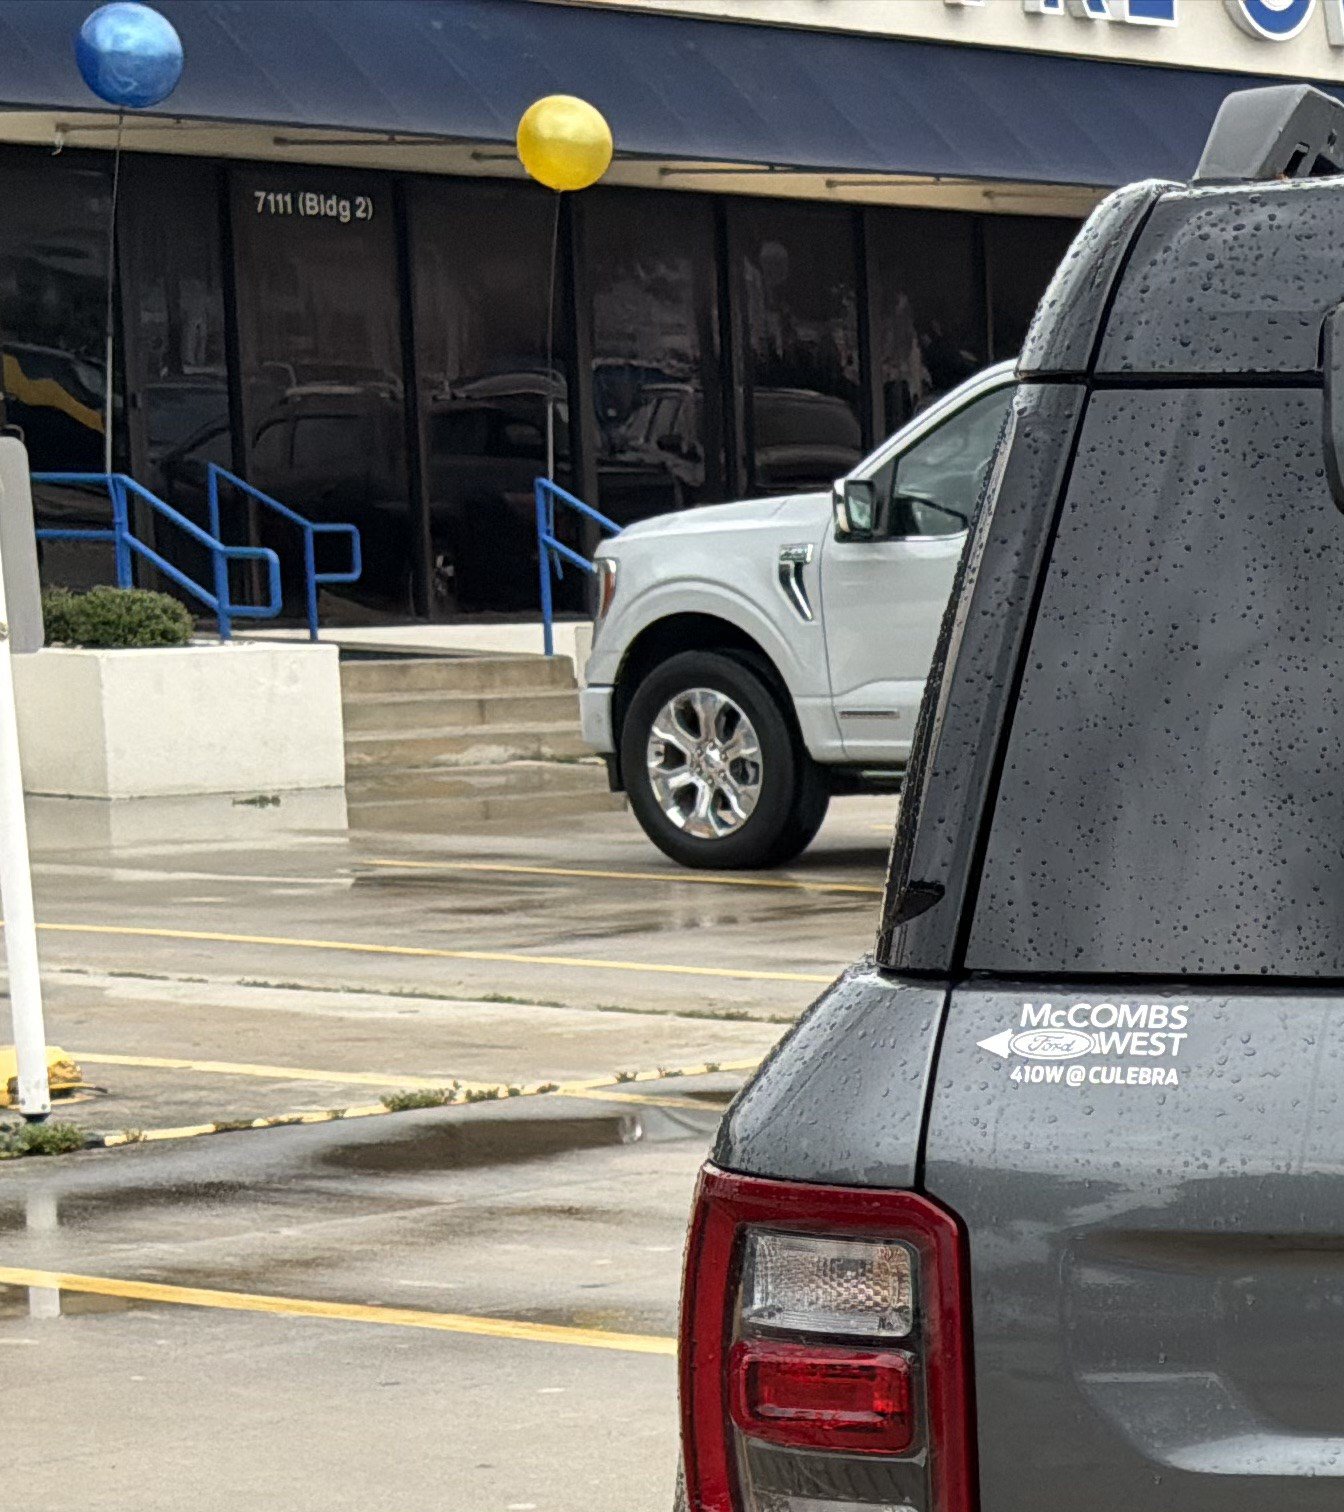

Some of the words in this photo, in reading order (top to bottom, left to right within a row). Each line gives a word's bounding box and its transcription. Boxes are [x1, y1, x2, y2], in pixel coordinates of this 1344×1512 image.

[254, 191, 293, 215] 7111
[298, 192, 351, 223] (Bldg
[355, 196, 374, 221] 2)
[1020, 1003, 1190, 1030] McCOMBS
[1027, 1034, 1077, 1053] Ford
[1098, 1031, 1188, 1057] WEST
[1088, 1067, 1179, 1086] CULEBRA
